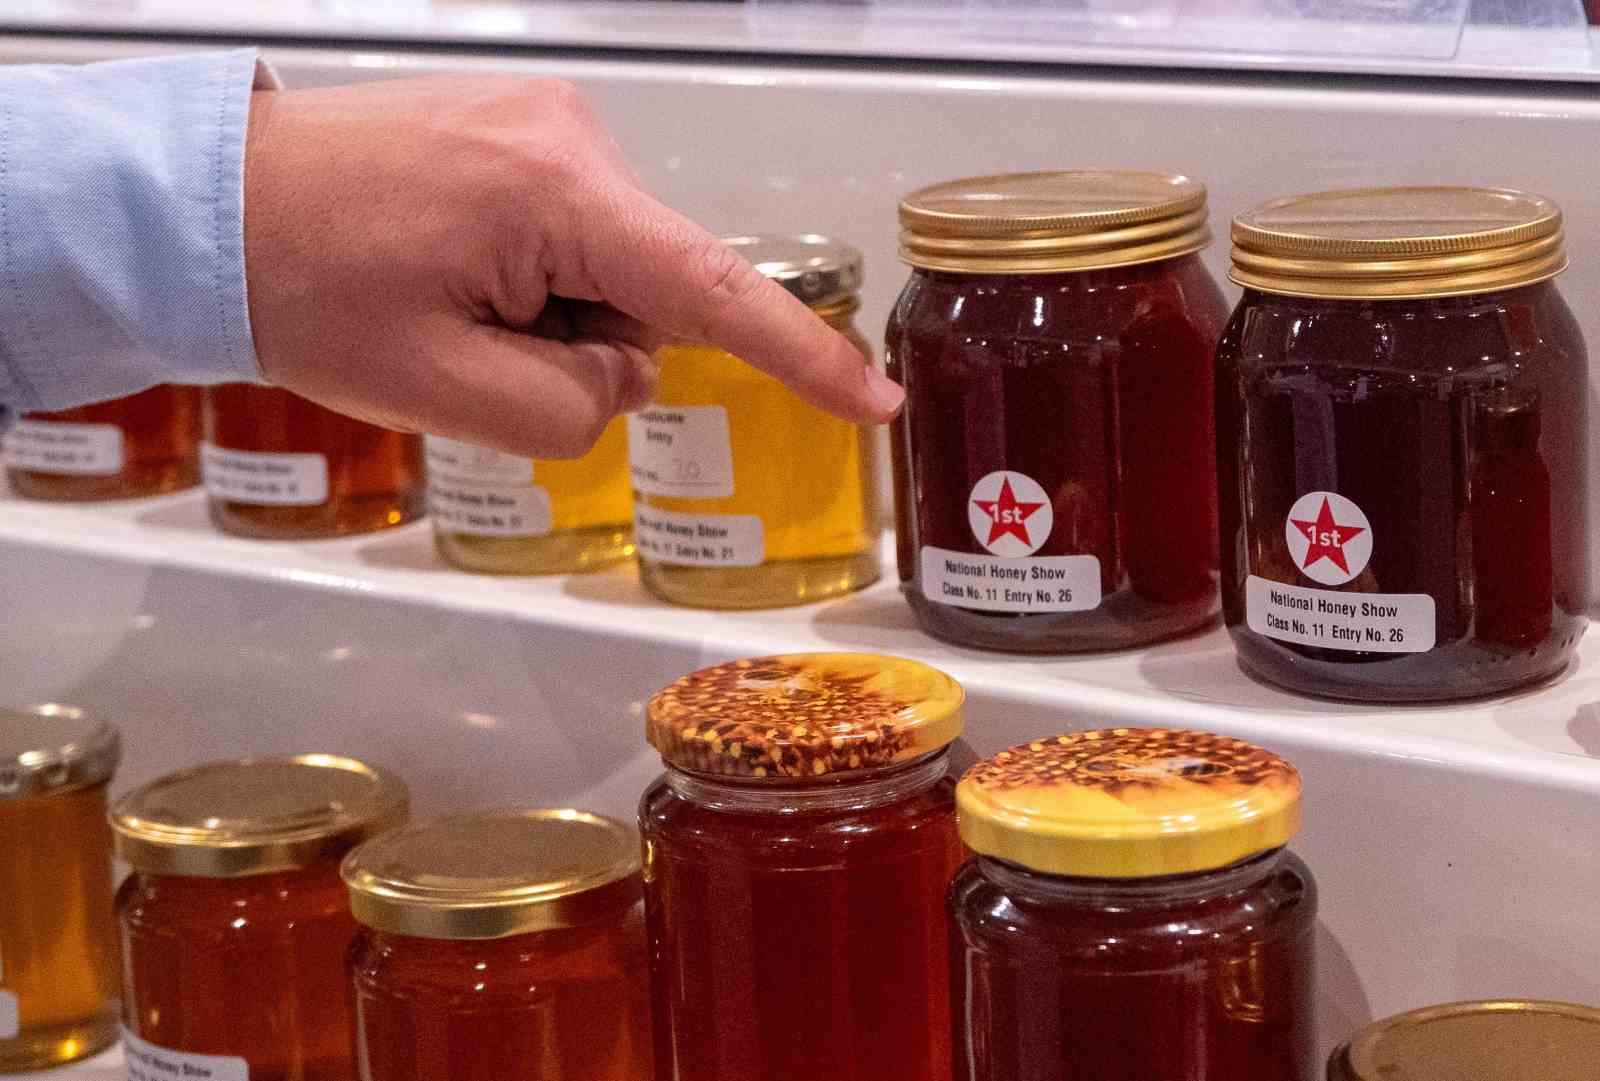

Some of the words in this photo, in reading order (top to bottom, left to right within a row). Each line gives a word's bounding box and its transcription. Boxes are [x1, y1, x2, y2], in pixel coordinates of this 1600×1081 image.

[988, 502, 1025, 524] 1st
[697, 523, 729, 537] Show
[1307, 525, 1342, 548] 1st
[945, 559, 986, 577] National
[990, 565, 1027, 581] Honey
[1031, 566, 1065, 580] Show
[943, 582, 964, 598] Class
[966, 586, 983, 600] No.
[987, 589, 998, 601] 11
[1004, 589, 1033, 606] Entry
[1036, 590, 1055, 603] No.
[1058, 589, 1073, 602] 26
[1270, 590, 1313, 611] National
[1318, 598, 1357, 619] Honey
[1361, 602, 1398, 618] Show
[1266, 613, 1289, 632] Class
[1292, 621, 1309, 635] No.
[1312, 623, 1324, 637] 11
[1332, 625, 1361, 643] Entry
[1365, 628, 1385, 642] No.
[1389, 628, 1404, 642] 26
